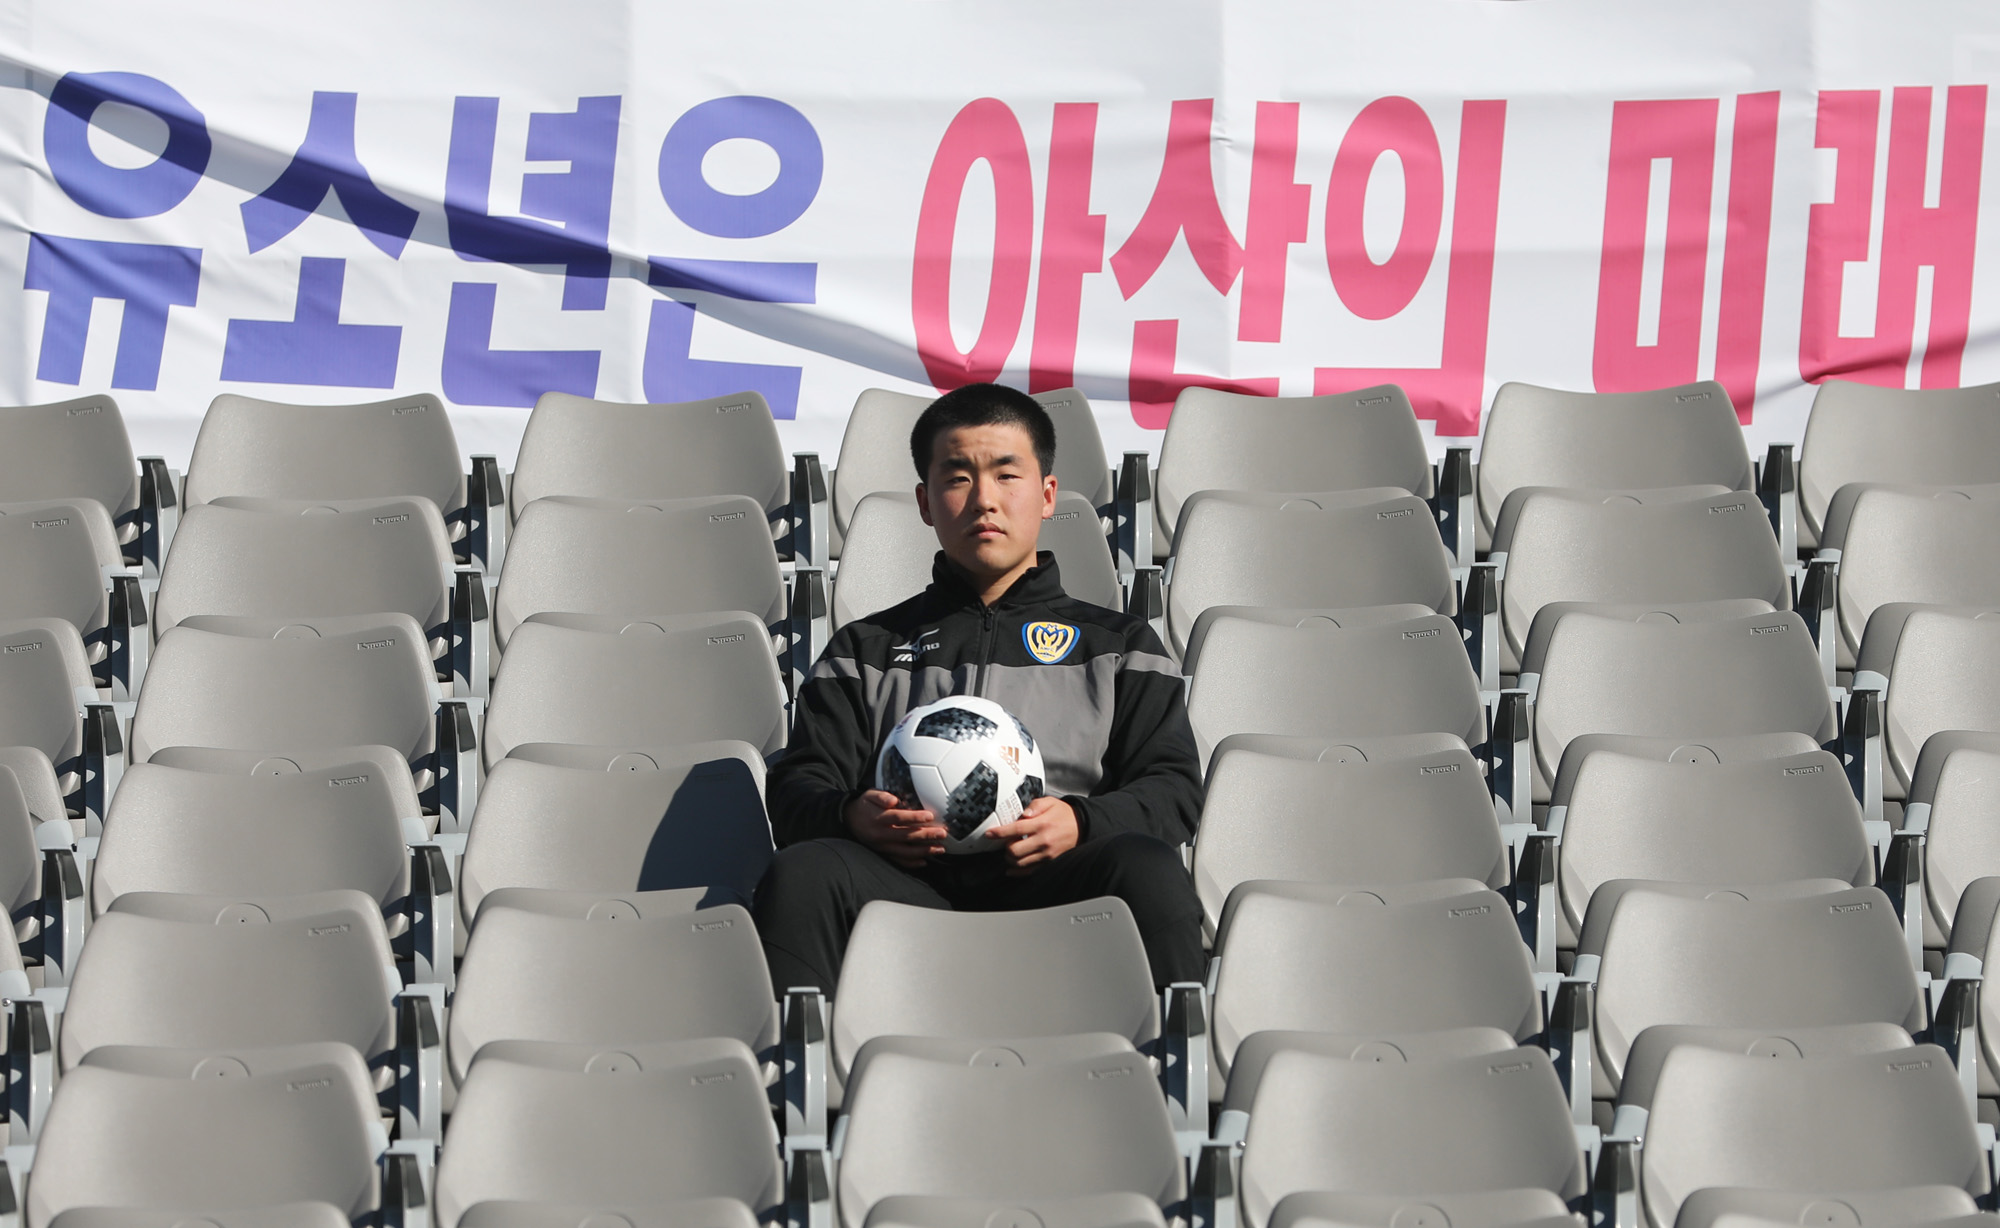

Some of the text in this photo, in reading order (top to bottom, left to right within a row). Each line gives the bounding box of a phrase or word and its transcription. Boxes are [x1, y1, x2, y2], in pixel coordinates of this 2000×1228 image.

[24, 71, 1987, 436] 유소년은 아산의 미래
